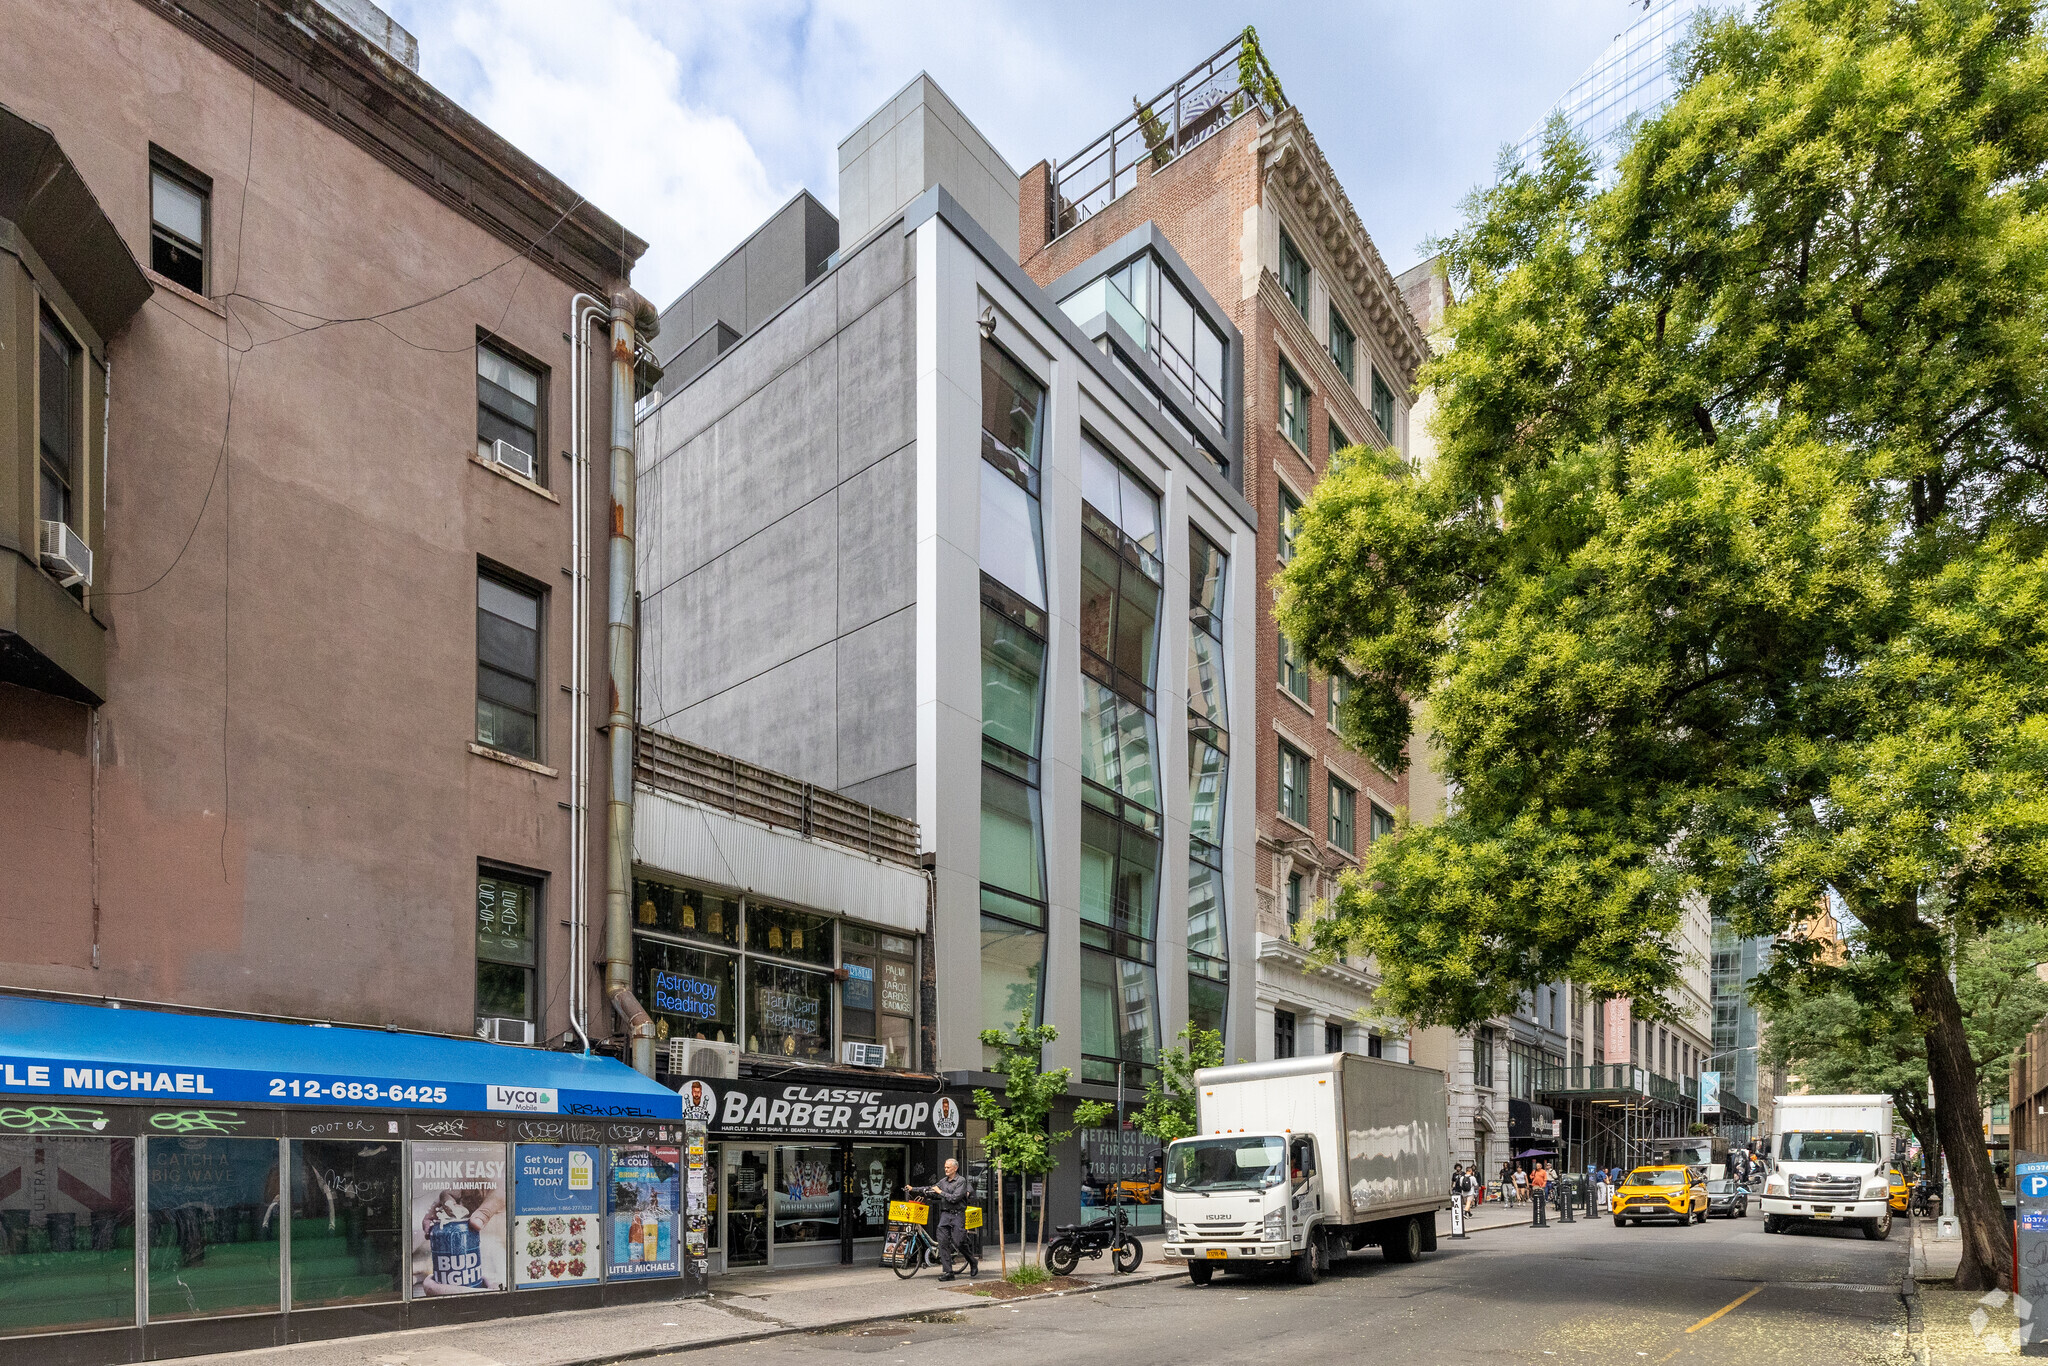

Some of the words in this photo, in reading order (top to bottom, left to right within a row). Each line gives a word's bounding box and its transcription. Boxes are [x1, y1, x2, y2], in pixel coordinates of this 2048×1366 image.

[479, 884, 495, 943] CRYSTAL
[886, 965, 905, 977] PALM
[656, 971, 717, 1000] Astrology
[883, 980, 907, 992] TAROT
[656, 990, 716, 1019] Readings
[882, 990, 908, 1003] CARDS
[794, 997, 818, 1015] Card
[766, 1010, 816, 1034] Readings
[0, 1064, 51, 1087] LE
[63, 1067, 214, 1094] MICHAEL
[269, 1078, 448, 1104] 212-683-6425
[497, 1087, 538, 1104] Lyca
[783, 1086, 883, 1105] CLASSIC
[515, 1104, 538, 1112] Mobile
[721, 1090, 852, 1128] BARBER
[858, 1102, 929, 1130] SHOP
[1081, 1128, 1119, 1143] RETAIL
[1123, 1131, 1160, 1145] CONDO
[1100, 1143, 1119, 1156] FOR
[1122, 1145, 1145, 1157] SALE
[158, 1153, 212, 1166] CATCH
[220, 1153, 229, 1166] A
[524, 1155, 541, 1164] Get
[542, 1155, 564, 1164] Your
[152, 1169, 180, 1182] BIG
[188, 1169, 236, 1182] WAVE
[414, 1161, 464, 1179] DRINK
[465, 1160, 506, 1179] EASY
[523, 1167, 540, 1175] SIM
[542, 1167, 564, 1175] Card
[34, 1168, 45, 1212] ULTRA
[422, 1182, 451, 1191] NOMAD,
[452, 1181, 497, 1190] MANHATTAN
[533, 1178, 564, 1186] TODAY
[2031, 1177, 2048, 1195] P
[437, 1252, 478, 1271] BUD
[609, 1265, 633, 1274] LITTLE
[635, 1262, 675, 1273] MICHAELS
